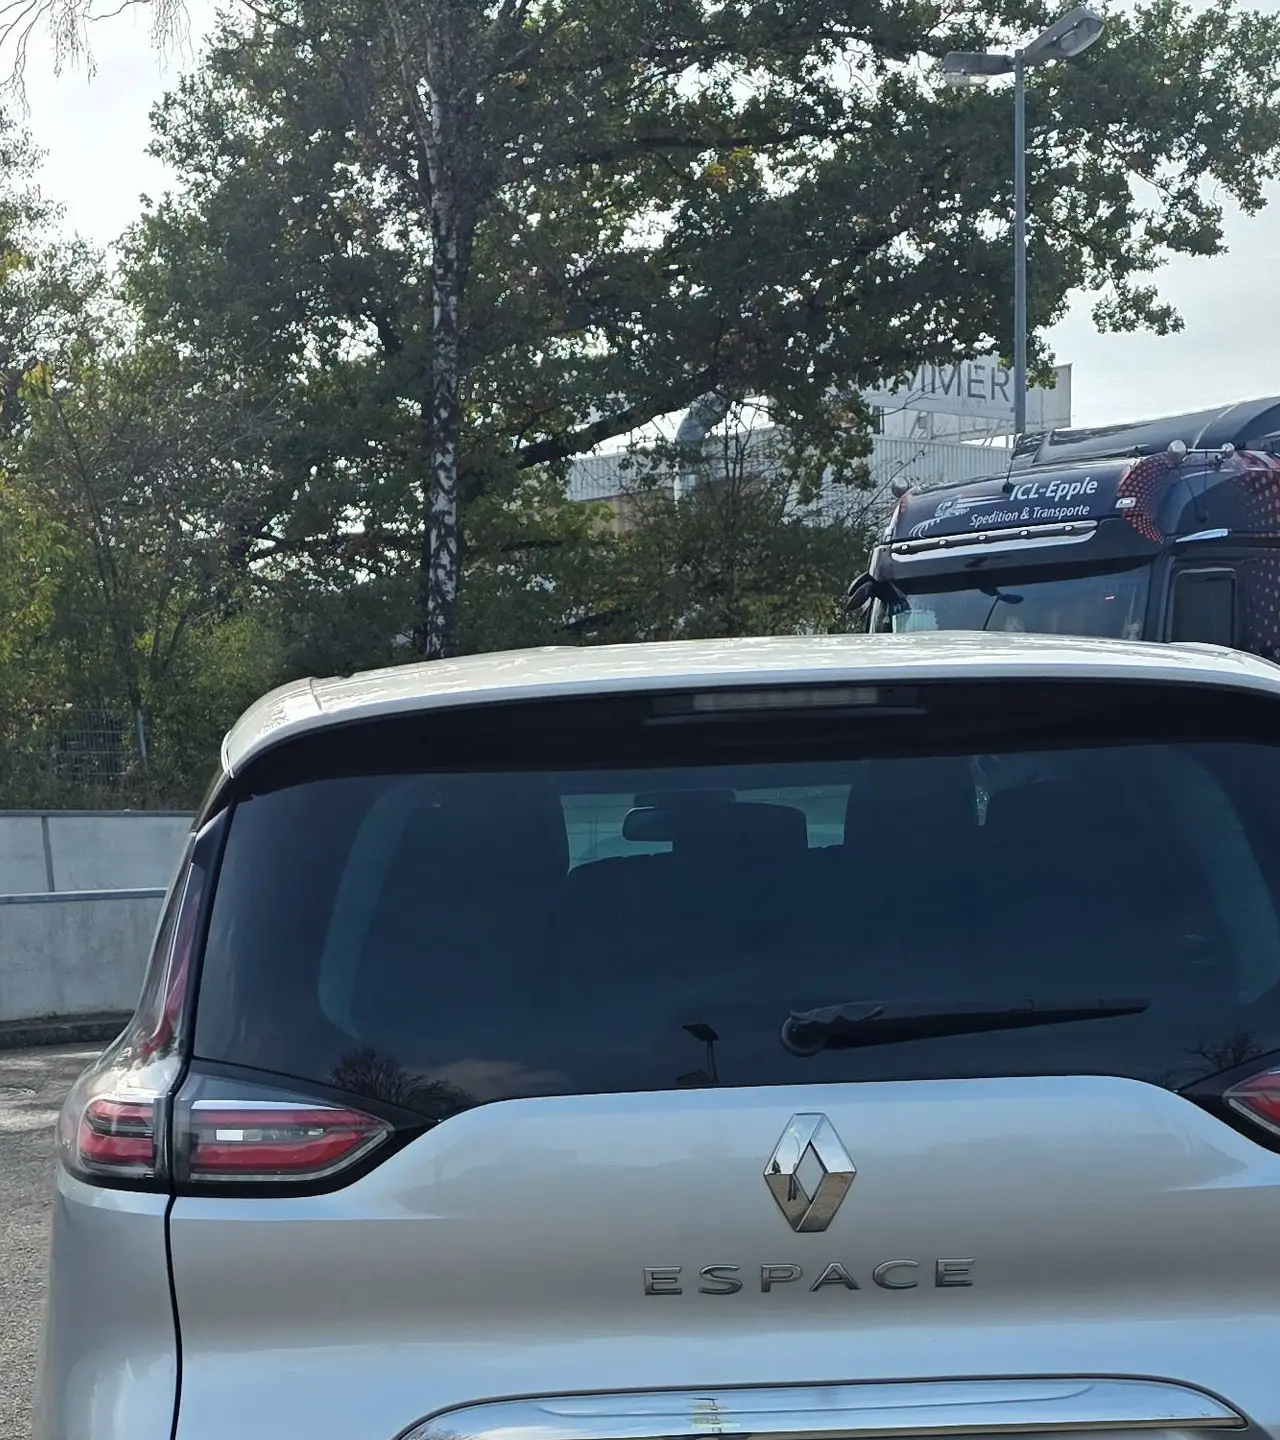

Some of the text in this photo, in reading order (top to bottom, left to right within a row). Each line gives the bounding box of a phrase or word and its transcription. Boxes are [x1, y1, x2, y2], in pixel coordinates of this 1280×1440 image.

[1009, 477, 1098, 501] ICL-Epple
[969, 503, 1090, 528] Spedition & Transporte
[642, 1257, 976, 1297] ESPACE
